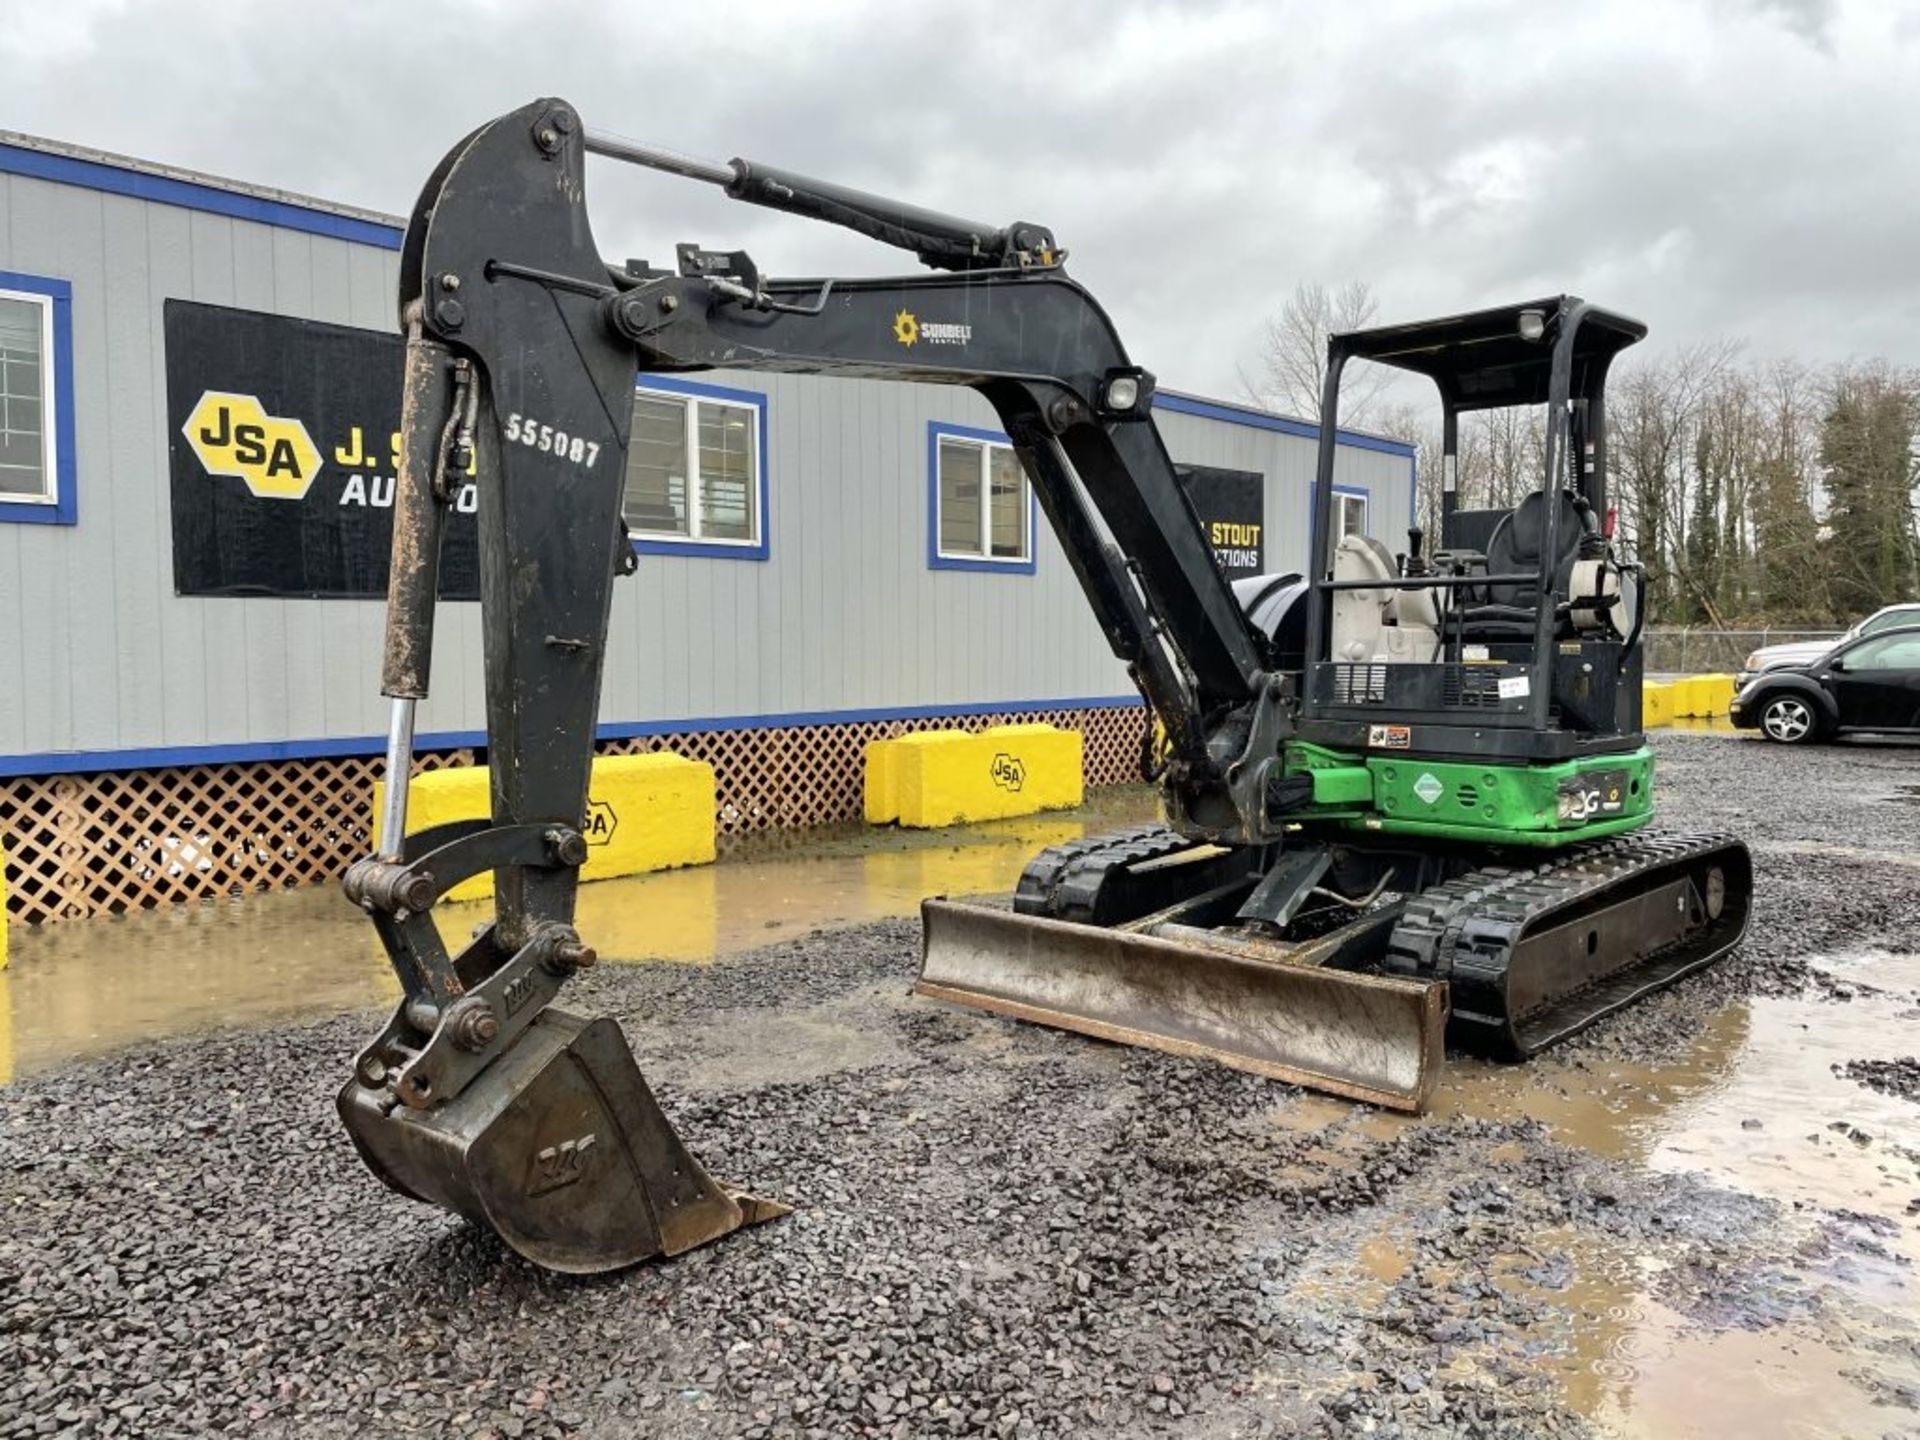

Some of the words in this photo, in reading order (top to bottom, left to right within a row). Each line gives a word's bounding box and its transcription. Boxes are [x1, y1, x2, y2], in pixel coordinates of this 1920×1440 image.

[921, 323, 972, 340] SUNBELT
[200, 406, 303, 479] JSA
[335, 426, 377, 467] J.
[504, 413, 600, 468] 555087
[1212, 523, 1261, 546] STOUT
[995, 759, 1019, 783] JSA
